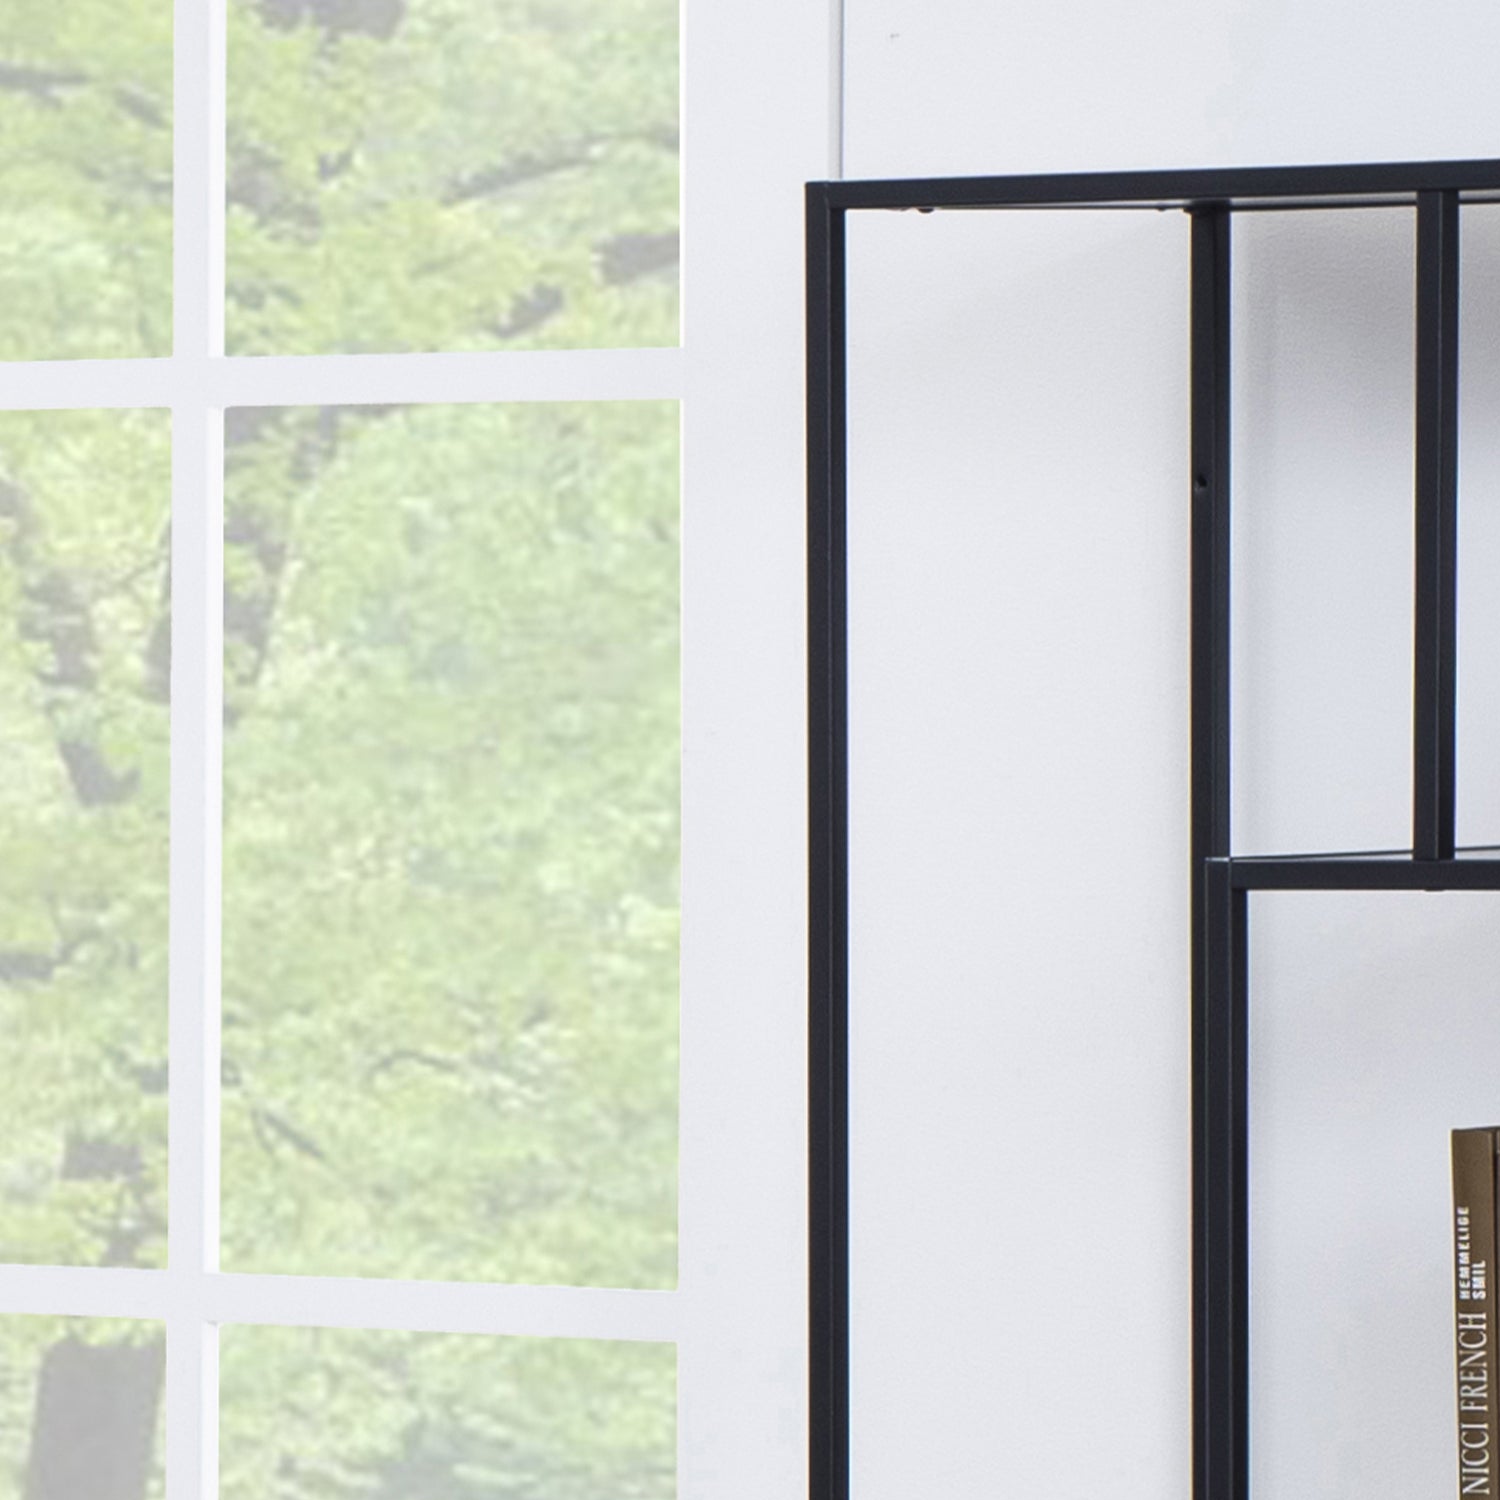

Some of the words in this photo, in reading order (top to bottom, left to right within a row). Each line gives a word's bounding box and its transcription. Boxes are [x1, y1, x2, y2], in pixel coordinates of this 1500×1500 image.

[1457, 1206, 1471, 1300] HEMMELIGE
[1472, 1260, 1486, 1300] SMIL
[1458, 1312, 1488, 1411] FRENCH
[1461, 1422, 1490, 1495] NICCI
